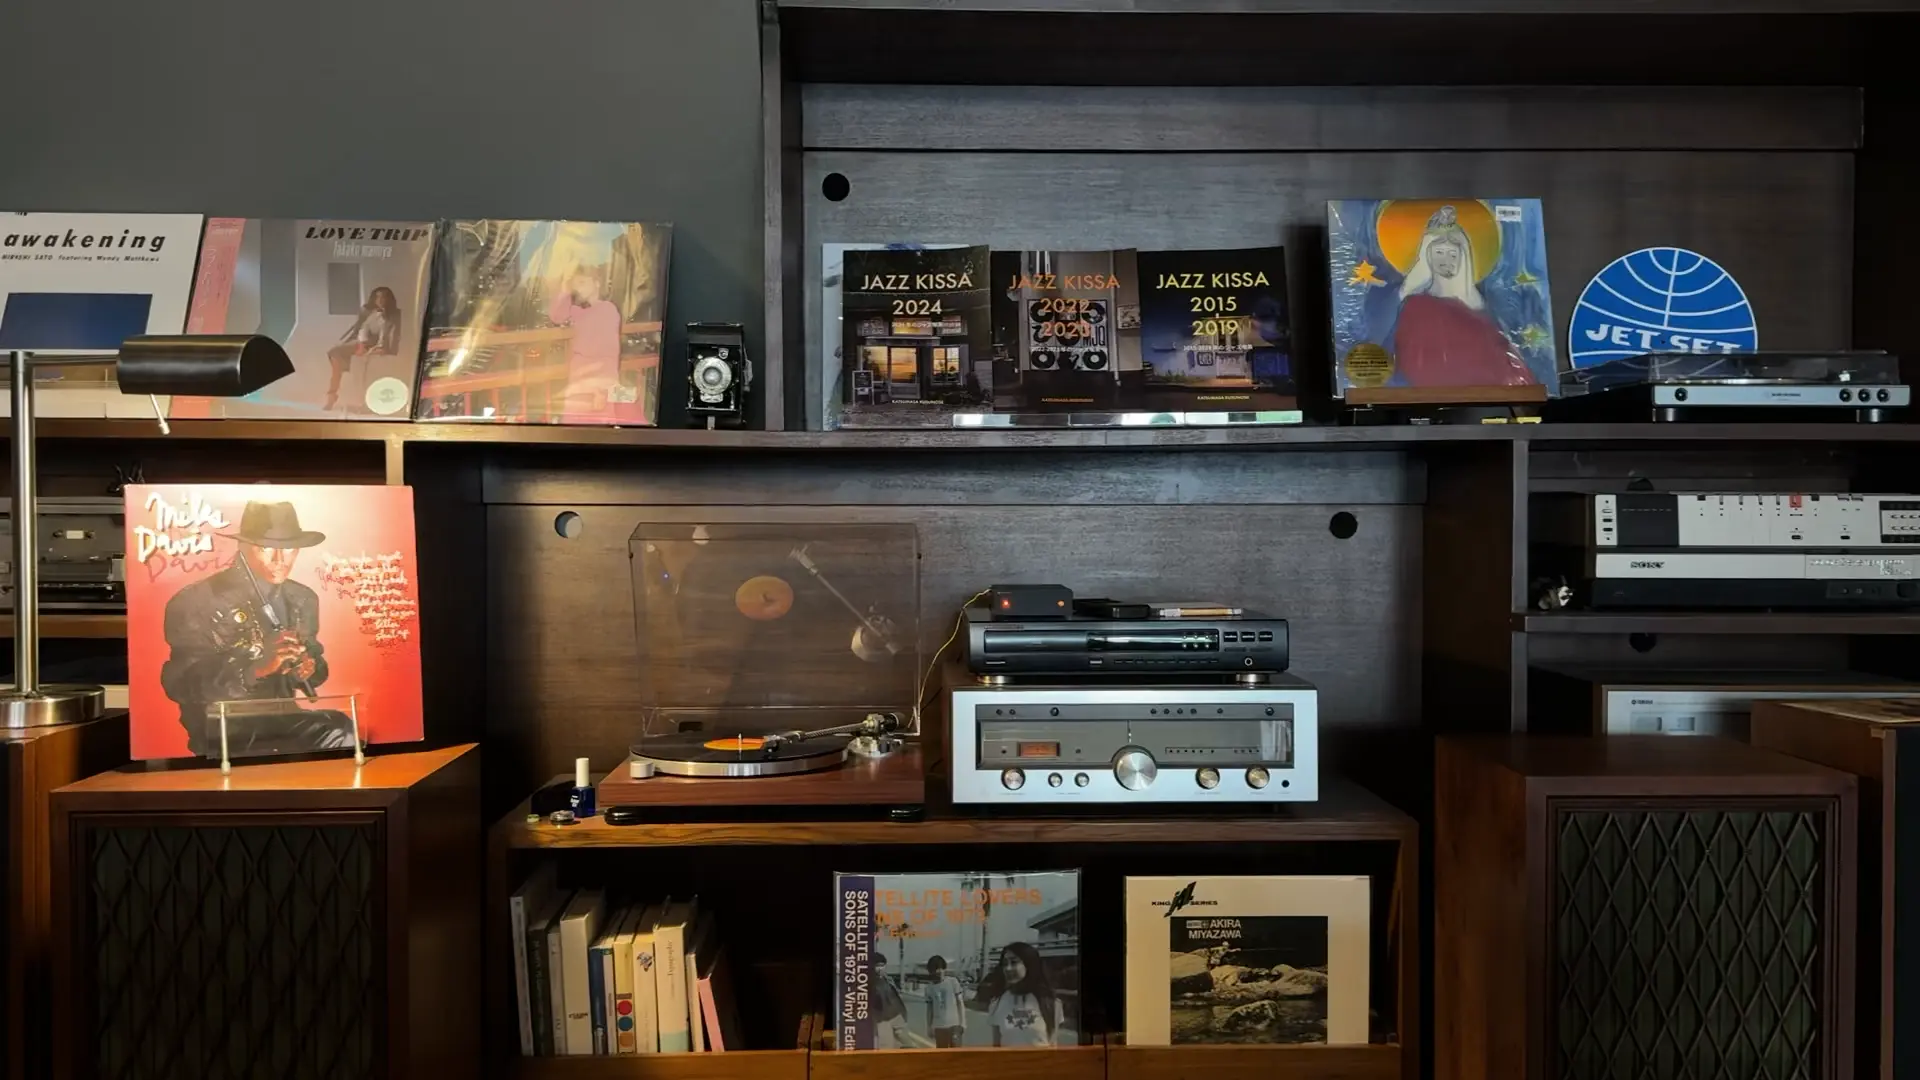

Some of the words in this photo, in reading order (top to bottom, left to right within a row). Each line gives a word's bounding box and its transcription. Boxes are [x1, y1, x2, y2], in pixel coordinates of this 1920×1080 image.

[4, 229, 166, 252] awakening
[305, 226, 366, 240] LOVE
[370, 228, 429, 241] TRIP
[861, 274, 910, 290] JAZZ
[916, 272, 973, 289] KISSA
[1009, 274, 1057, 290] JAZZ
[1063, 274, 1120, 290] KISSA
[1156, 274, 1205, 290] JAZZ
[1211, 271, 1270, 288] KISSA
[892, 299, 942, 315] 2024
[1190, 296, 1237, 312] 2015
[1192, 320, 1238, 336] 2019
[1586, 323, 1661, 350] JET
[133, 525, 214, 564] Davis
[959, 888, 1043, 905] LOVERS
[845, 891, 856, 929] SONS
[857, 891, 868, 960] SATELLITE
[1210, 919, 1242, 928] AKIRA
[845, 933, 856, 951] OF
[1188, 930, 1242, 939] MIYAZAWA
[845, 955, 856, 983] 1973
[857, 966, 868, 1020] LOVERS
